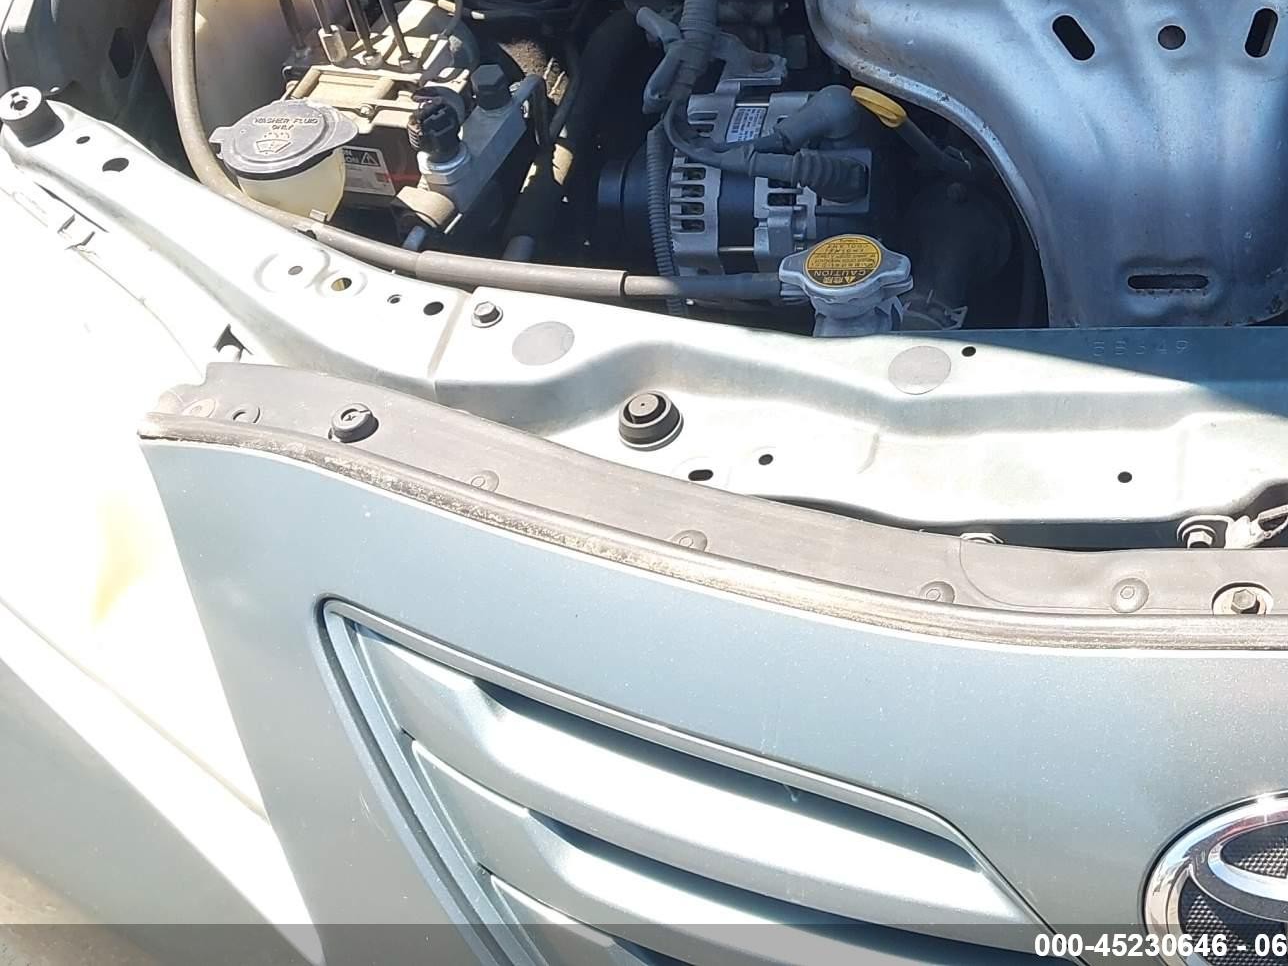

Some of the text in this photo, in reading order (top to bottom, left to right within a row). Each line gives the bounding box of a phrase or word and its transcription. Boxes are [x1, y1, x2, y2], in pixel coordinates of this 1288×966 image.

[254, 117, 319, 125] WASHER FLUID
[813, 269, 867, 277] CAUTION
